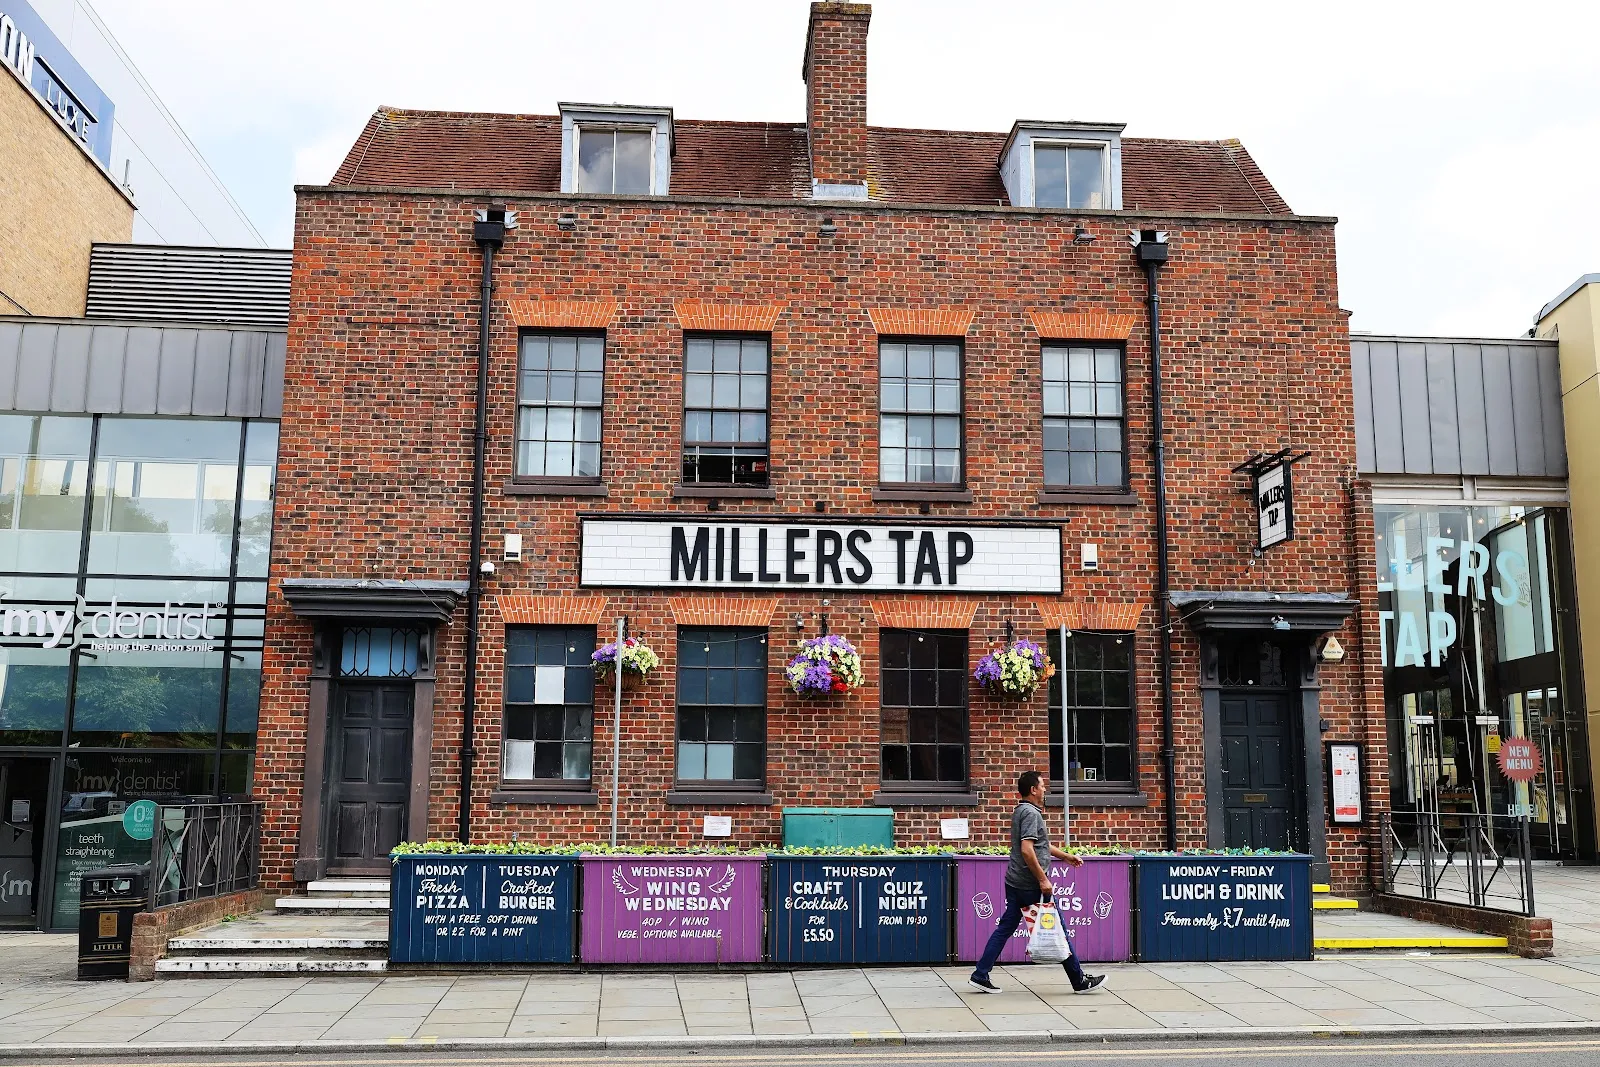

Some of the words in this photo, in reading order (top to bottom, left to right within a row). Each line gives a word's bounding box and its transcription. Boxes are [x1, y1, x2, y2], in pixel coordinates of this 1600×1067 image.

[45, 80, 89, 143] LUXE
[670, 526, 873, 585] MILLERS
[888, 530, 974, 586] TAP
[1377, 536, 1525, 607] LERS
[1380, 611, 1456, 667] TAP
[91, 640, 129, 653] helping
[132, 640, 151, 651] the
[151, 641, 183, 652] nation
[187, 642, 214, 652] smile
[1509, 746, 1530, 757] NEW
[1506, 758, 1534, 770] MENU
[79, 833, 104, 844] teeth
[65, 846, 115, 858] straightening
[416, 865, 468, 875] MONDAY
[499, 866, 559, 876] TUESDAY
[631, 866, 712, 878] WEDNESDAY
[822, 866, 896, 877] THURSDAY
[418, 878, 462, 893] Fresh
[501, 878, 554, 895] Crafted
[647, 881, 701, 896] WING
[793, 881, 843, 895] CRAFT
[883, 881, 923, 896] QUIZ
[1162, 883, 1214, 900] LUNCH
[1219, 884, 1231, 900] &
[1236, 883, 1285, 901] DRINK
[416, 896, 470, 909] PIZZA
[499, 896, 556, 910] BURGER
[625, 897, 732, 911] WEDNESDAY
[879, 896, 928, 910] NIGHT
[425, 915, 445, 924] WITH
[449, 915, 455, 924] A
[458, 914, 481, 923] FREE
[487, 915, 509, 924] SOFT
[511, 915, 538, 924] DRINK
[642, 917, 662, 926] 40P
[669, 917, 677, 926] /
[681, 917, 710, 926] WING
[808, 916, 825, 925] FOR
[878, 916, 903, 925] FROM
[906, 916, 928, 925] 19:30
[1070, 917, 1092, 926] £4.25
[1161, 911, 1192, 926] From
[1192, 912, 1221, 930] only
[1223, 907, 1243, 928] £7
[1243, 913, 1268, 927] until
[1268, 913, 1291, 929] 4pm
[437, 927, 448, 936] OR
[452, 927, 465, 936] £2
[470, 927, 486, 936] FOR
[492, 927, 497, 936] A
[503, 927, 524, 936] PINT
[617, 930, 639, 939] VEGE.
[643, 930, 677, 939] OPTIONS
[681, 929, 722, 939] AVAILABLE
[803, 928, 834, 942] £5.50
[93, 943, 122, 951] LITTER
